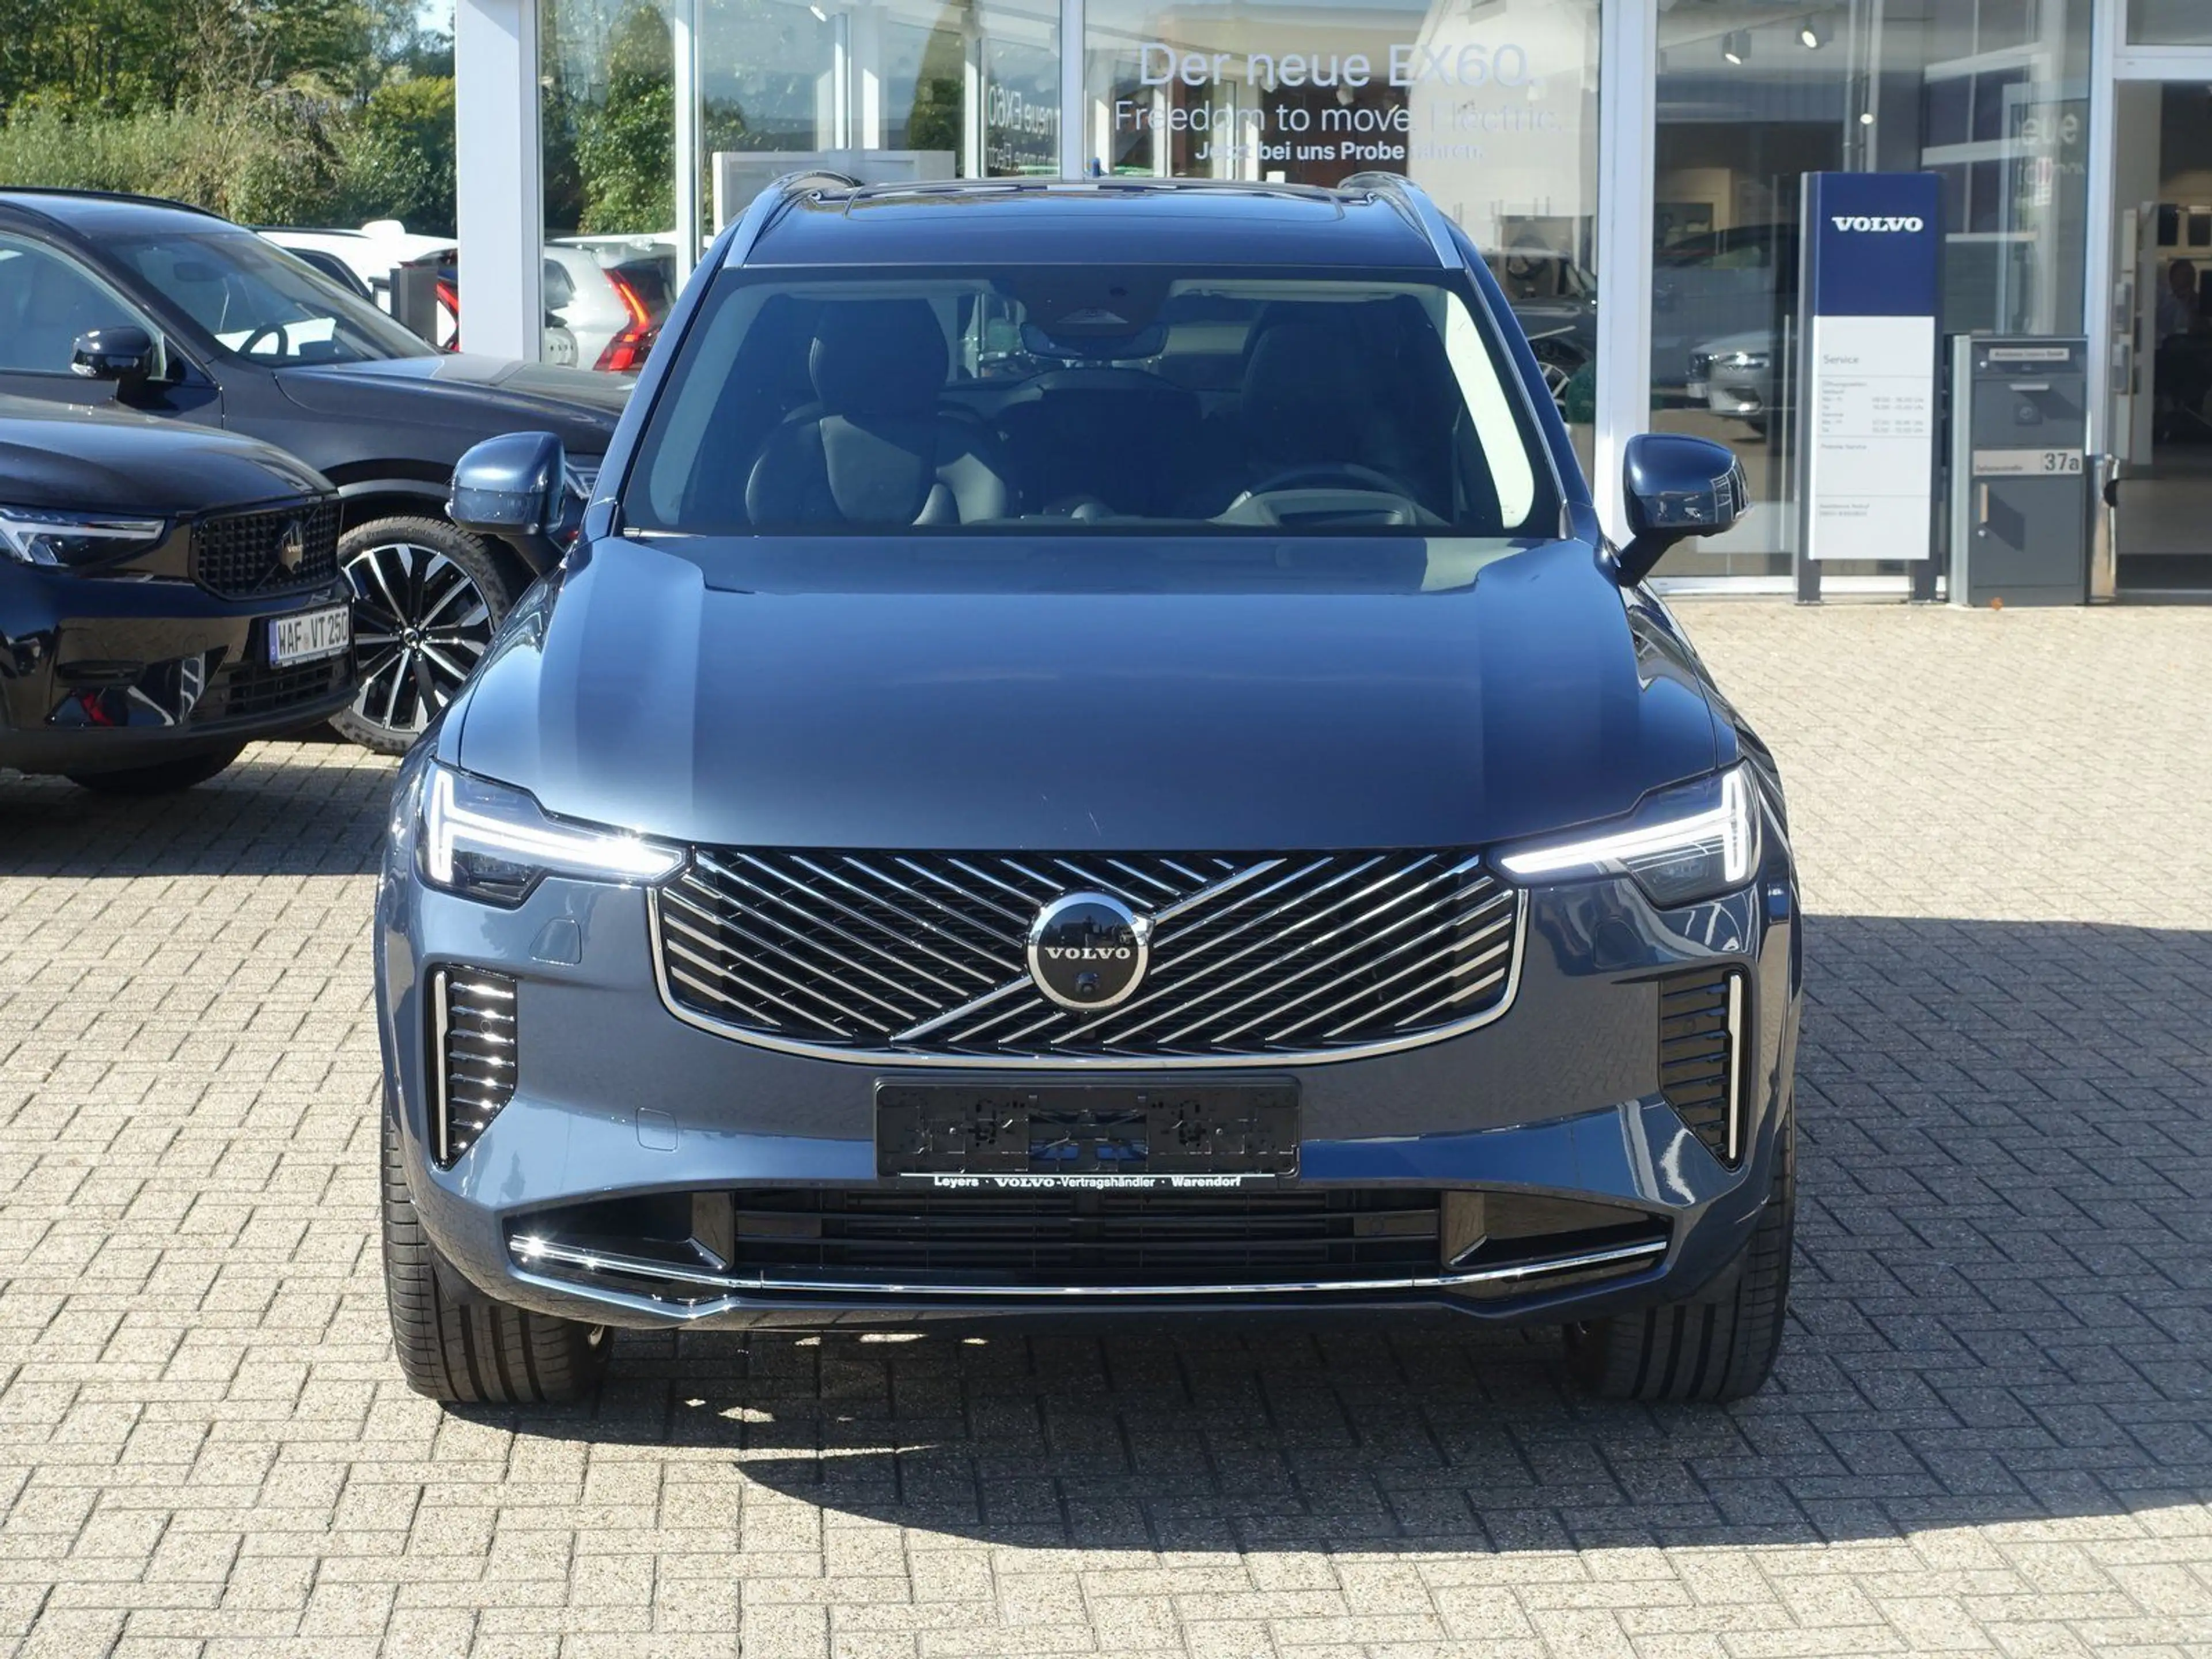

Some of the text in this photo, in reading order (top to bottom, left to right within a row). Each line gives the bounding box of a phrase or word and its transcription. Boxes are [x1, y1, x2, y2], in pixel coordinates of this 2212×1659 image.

[1139, 43, 1232, 86] Der
[1247, 52, 1370, 87] neue
[1115, 100, 1265, 131] Freedom
[1275, 104, 1310, 131] to
[1259, 141, 1291, 160] bei
[1297, 146, 1335, 160] uns
[1340, 142, 1405, 160] Probe
[1831, 217, 1924, 232] VOLVO
[1823, 354, 1859, 364] Service
[2044, 452, 2080, 471] 37a
[278, 620, 302, 656] WAF
[311, 616, 325, 649] VT
[1045, 947, 1131, 960] VOLVO
[934, 1176, 979, 1189] Leyers
[1171, 1176, 1242, 1187] Warendorf
